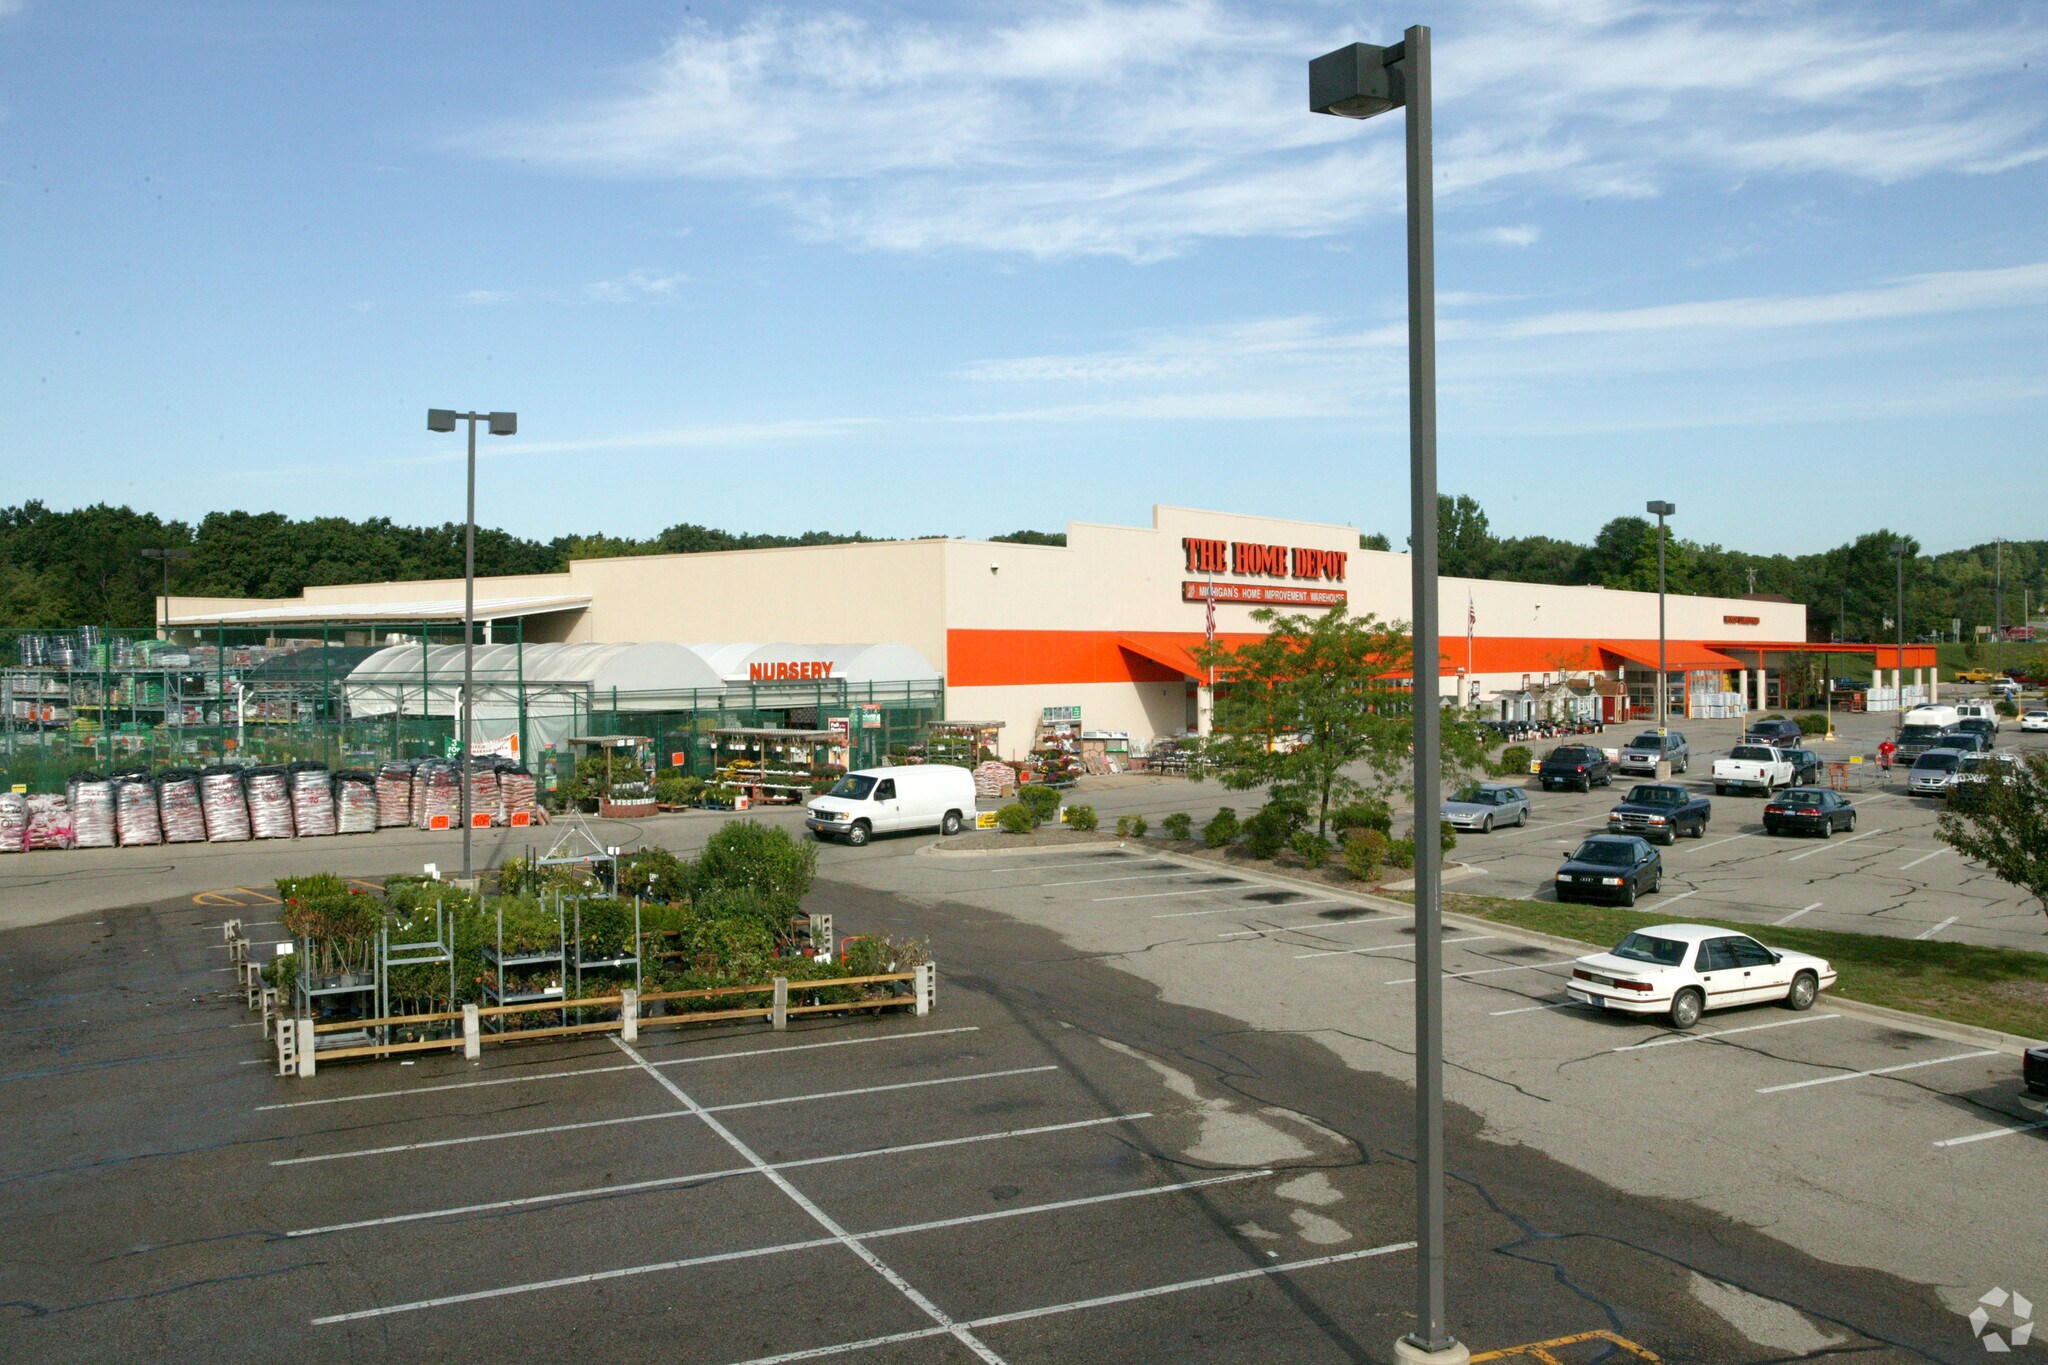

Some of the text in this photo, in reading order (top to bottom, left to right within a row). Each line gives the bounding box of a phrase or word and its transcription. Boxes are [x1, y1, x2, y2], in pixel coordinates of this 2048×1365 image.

[1183, 537, 1348, 580] THE HOME DEPOT
[1242, 588, 1261, 600] HOME
[1264, 589, 1307, 601] IMPROVEMENT
[749, 661, 833, 681] NURSERY
[451, 739, 458, 747] 3
